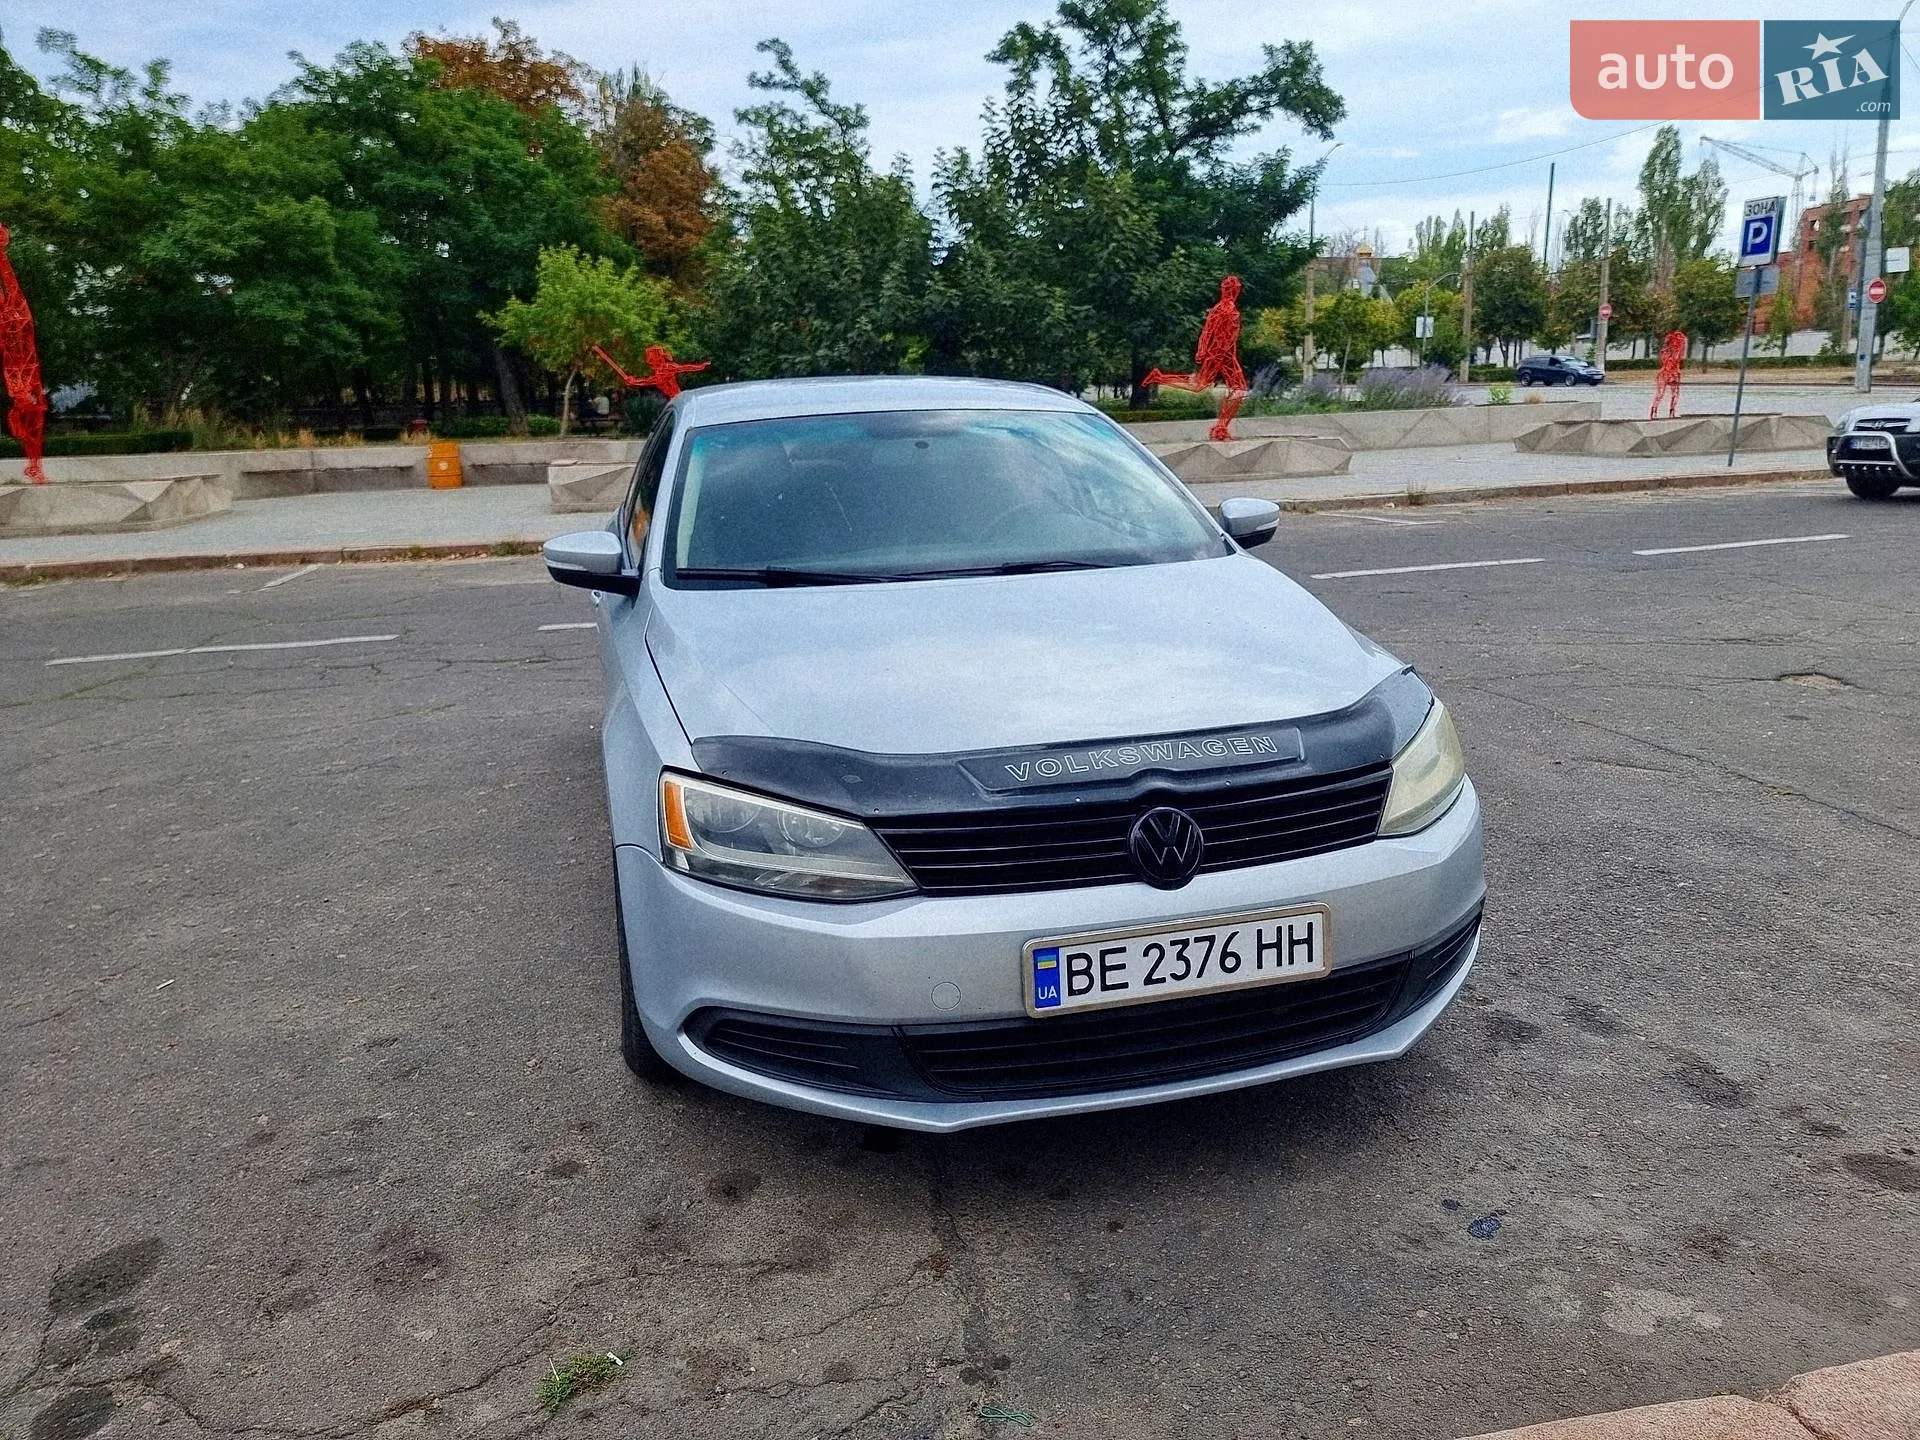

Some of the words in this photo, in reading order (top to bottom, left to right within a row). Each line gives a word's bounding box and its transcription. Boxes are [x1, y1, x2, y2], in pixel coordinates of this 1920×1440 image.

[1005, 736, 1278, 781] VOLKSWAGEN
[1066, 946, 1129, 997] BE
[1143, 931, 1242, 986] 2376
[1256, 921, 1314, 970] HH
[1038, 985, 1058, 1000] UA
